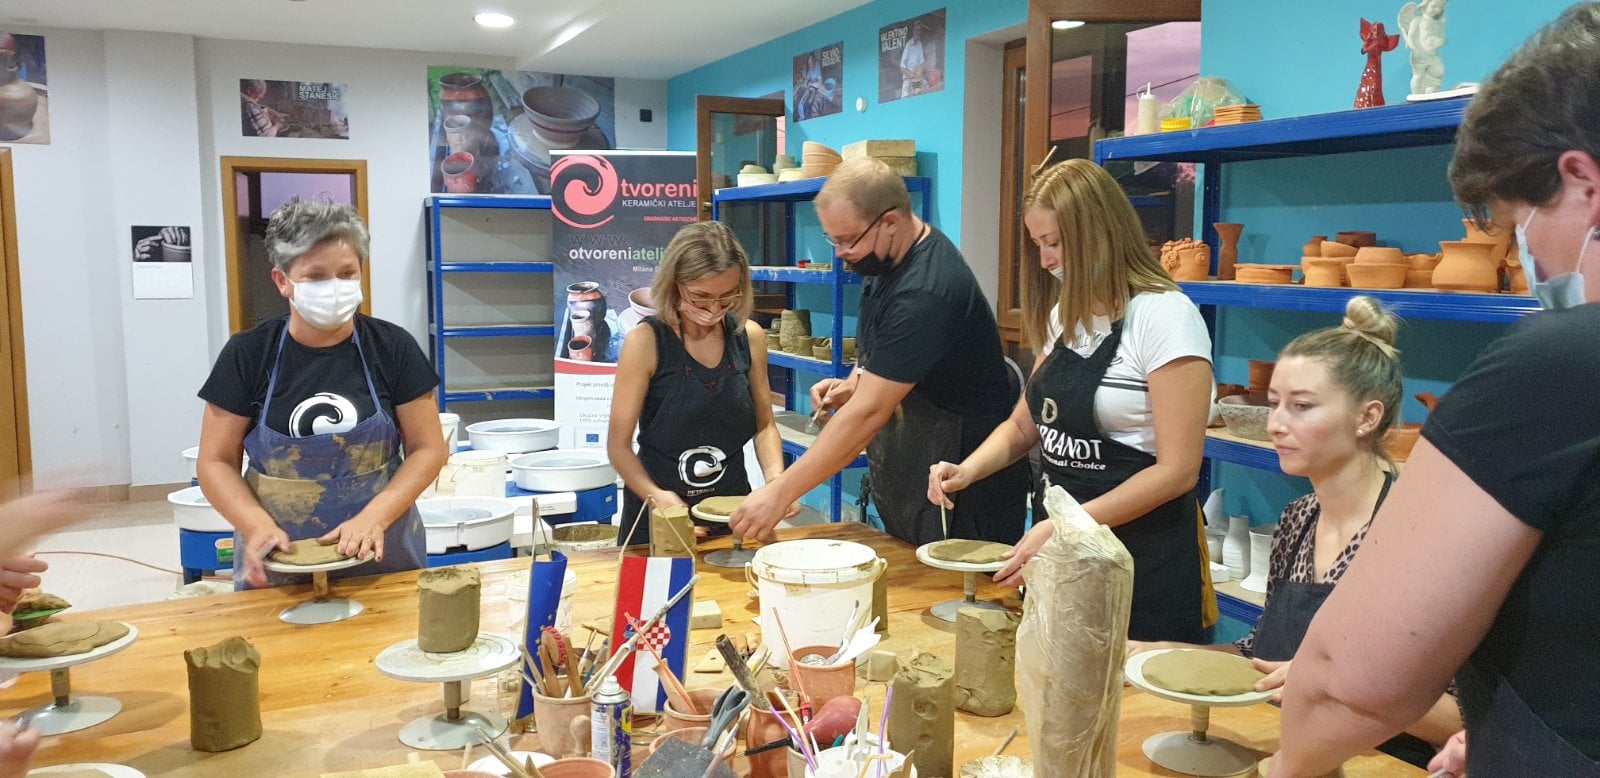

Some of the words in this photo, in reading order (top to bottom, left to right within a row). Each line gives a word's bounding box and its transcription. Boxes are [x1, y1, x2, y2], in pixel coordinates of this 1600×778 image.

[880, 26, 908, 42] VALENTINO
[881, 35, 906, 52] VALENT
[622, 199, 666, 207] KERAMIČKI
[668, 200, 697, 208] ATELJE
[1070, 461, 1106, 471] Choice
